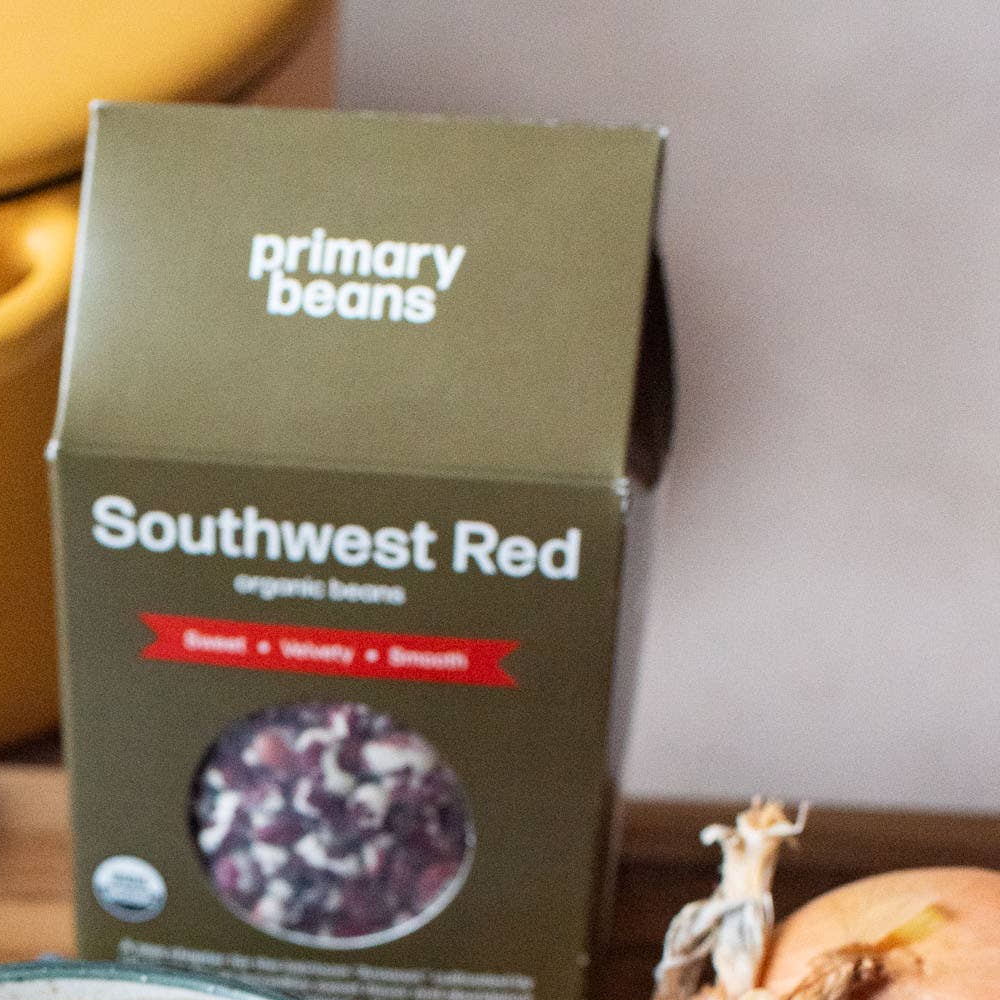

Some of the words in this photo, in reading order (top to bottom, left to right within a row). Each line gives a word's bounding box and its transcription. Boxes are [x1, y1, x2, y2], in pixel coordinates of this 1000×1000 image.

[248, 229, 467, 291] primary
[267, 268, 437, 324] beans
[92, 496, 437, 572] Southwest
[453, 520, 582, 581] Red
[232, 573, 326, 602] organic
[328, 576, 407, 605] beans
